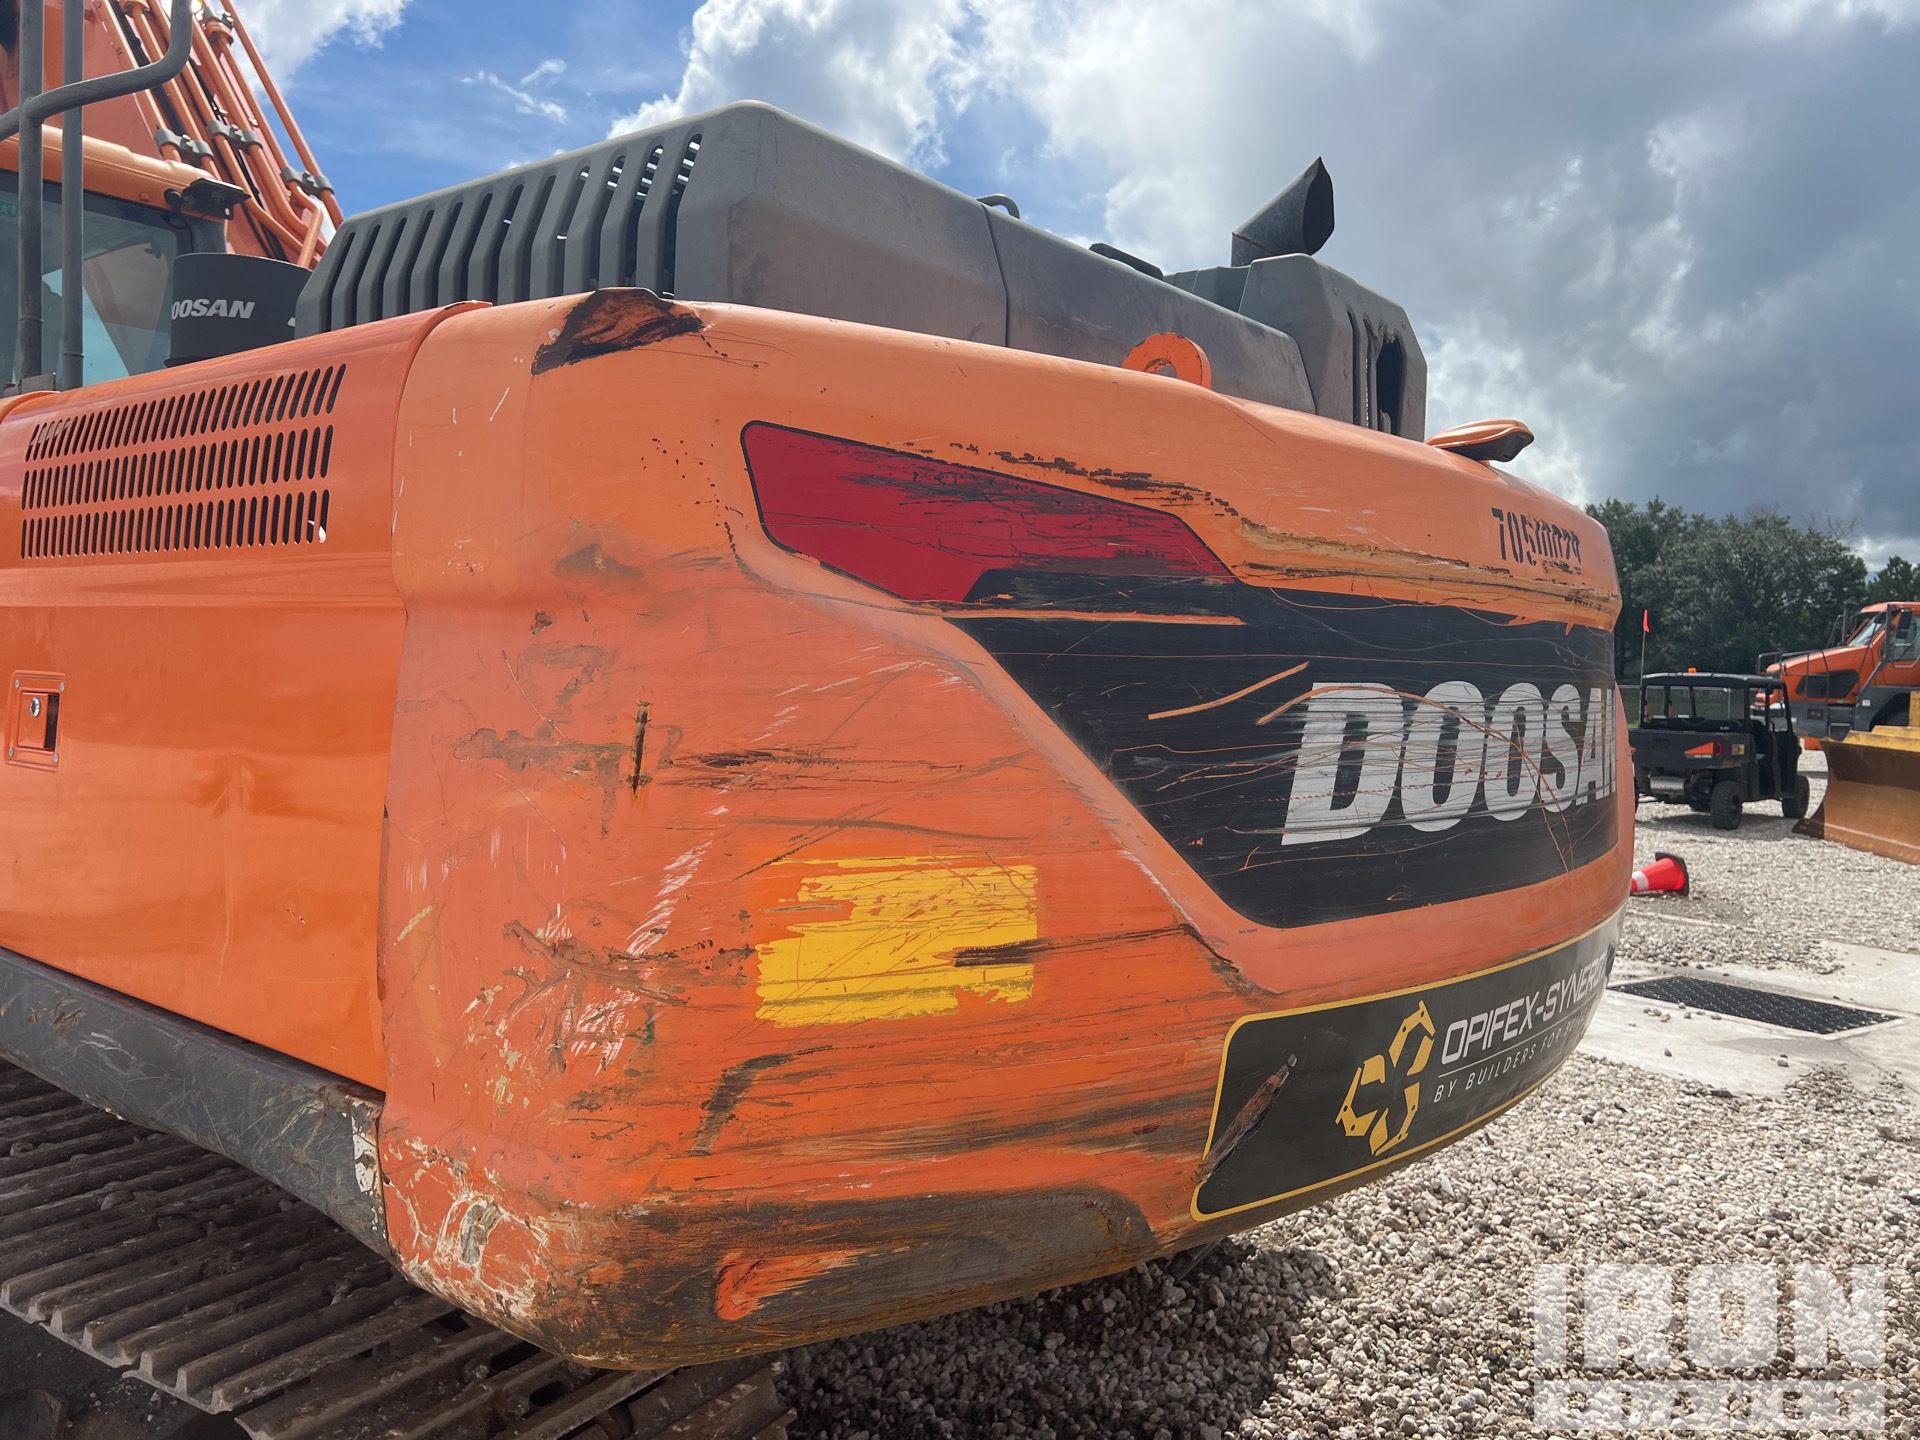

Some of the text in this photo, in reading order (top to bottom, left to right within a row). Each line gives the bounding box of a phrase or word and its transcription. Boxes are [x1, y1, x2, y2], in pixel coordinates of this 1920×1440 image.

[171, 298, 256, 321] OOSAN
[1433, 1078, 1458, 1104] BY
[1465, 1045, 1536, 1091] BUILDERS
[1540, 1025, 1562, 1054] FOR
